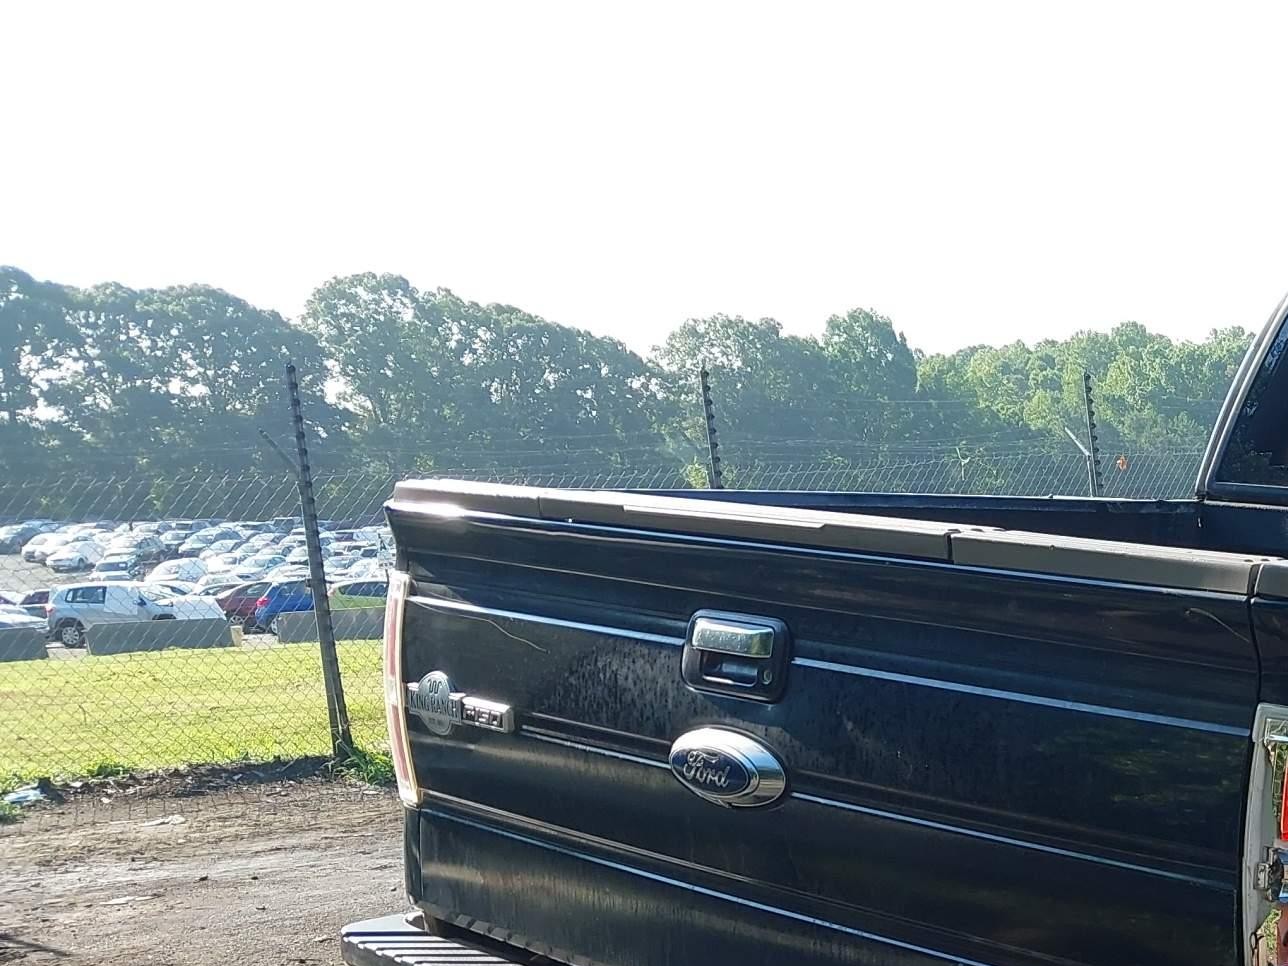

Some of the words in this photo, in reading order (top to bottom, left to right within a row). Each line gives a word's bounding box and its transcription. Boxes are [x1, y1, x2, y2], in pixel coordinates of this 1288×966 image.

[410, 690, 430, 713] KING
[430, 694, 458, 719] RANCH
[683, 750, 731, 788] Ford
